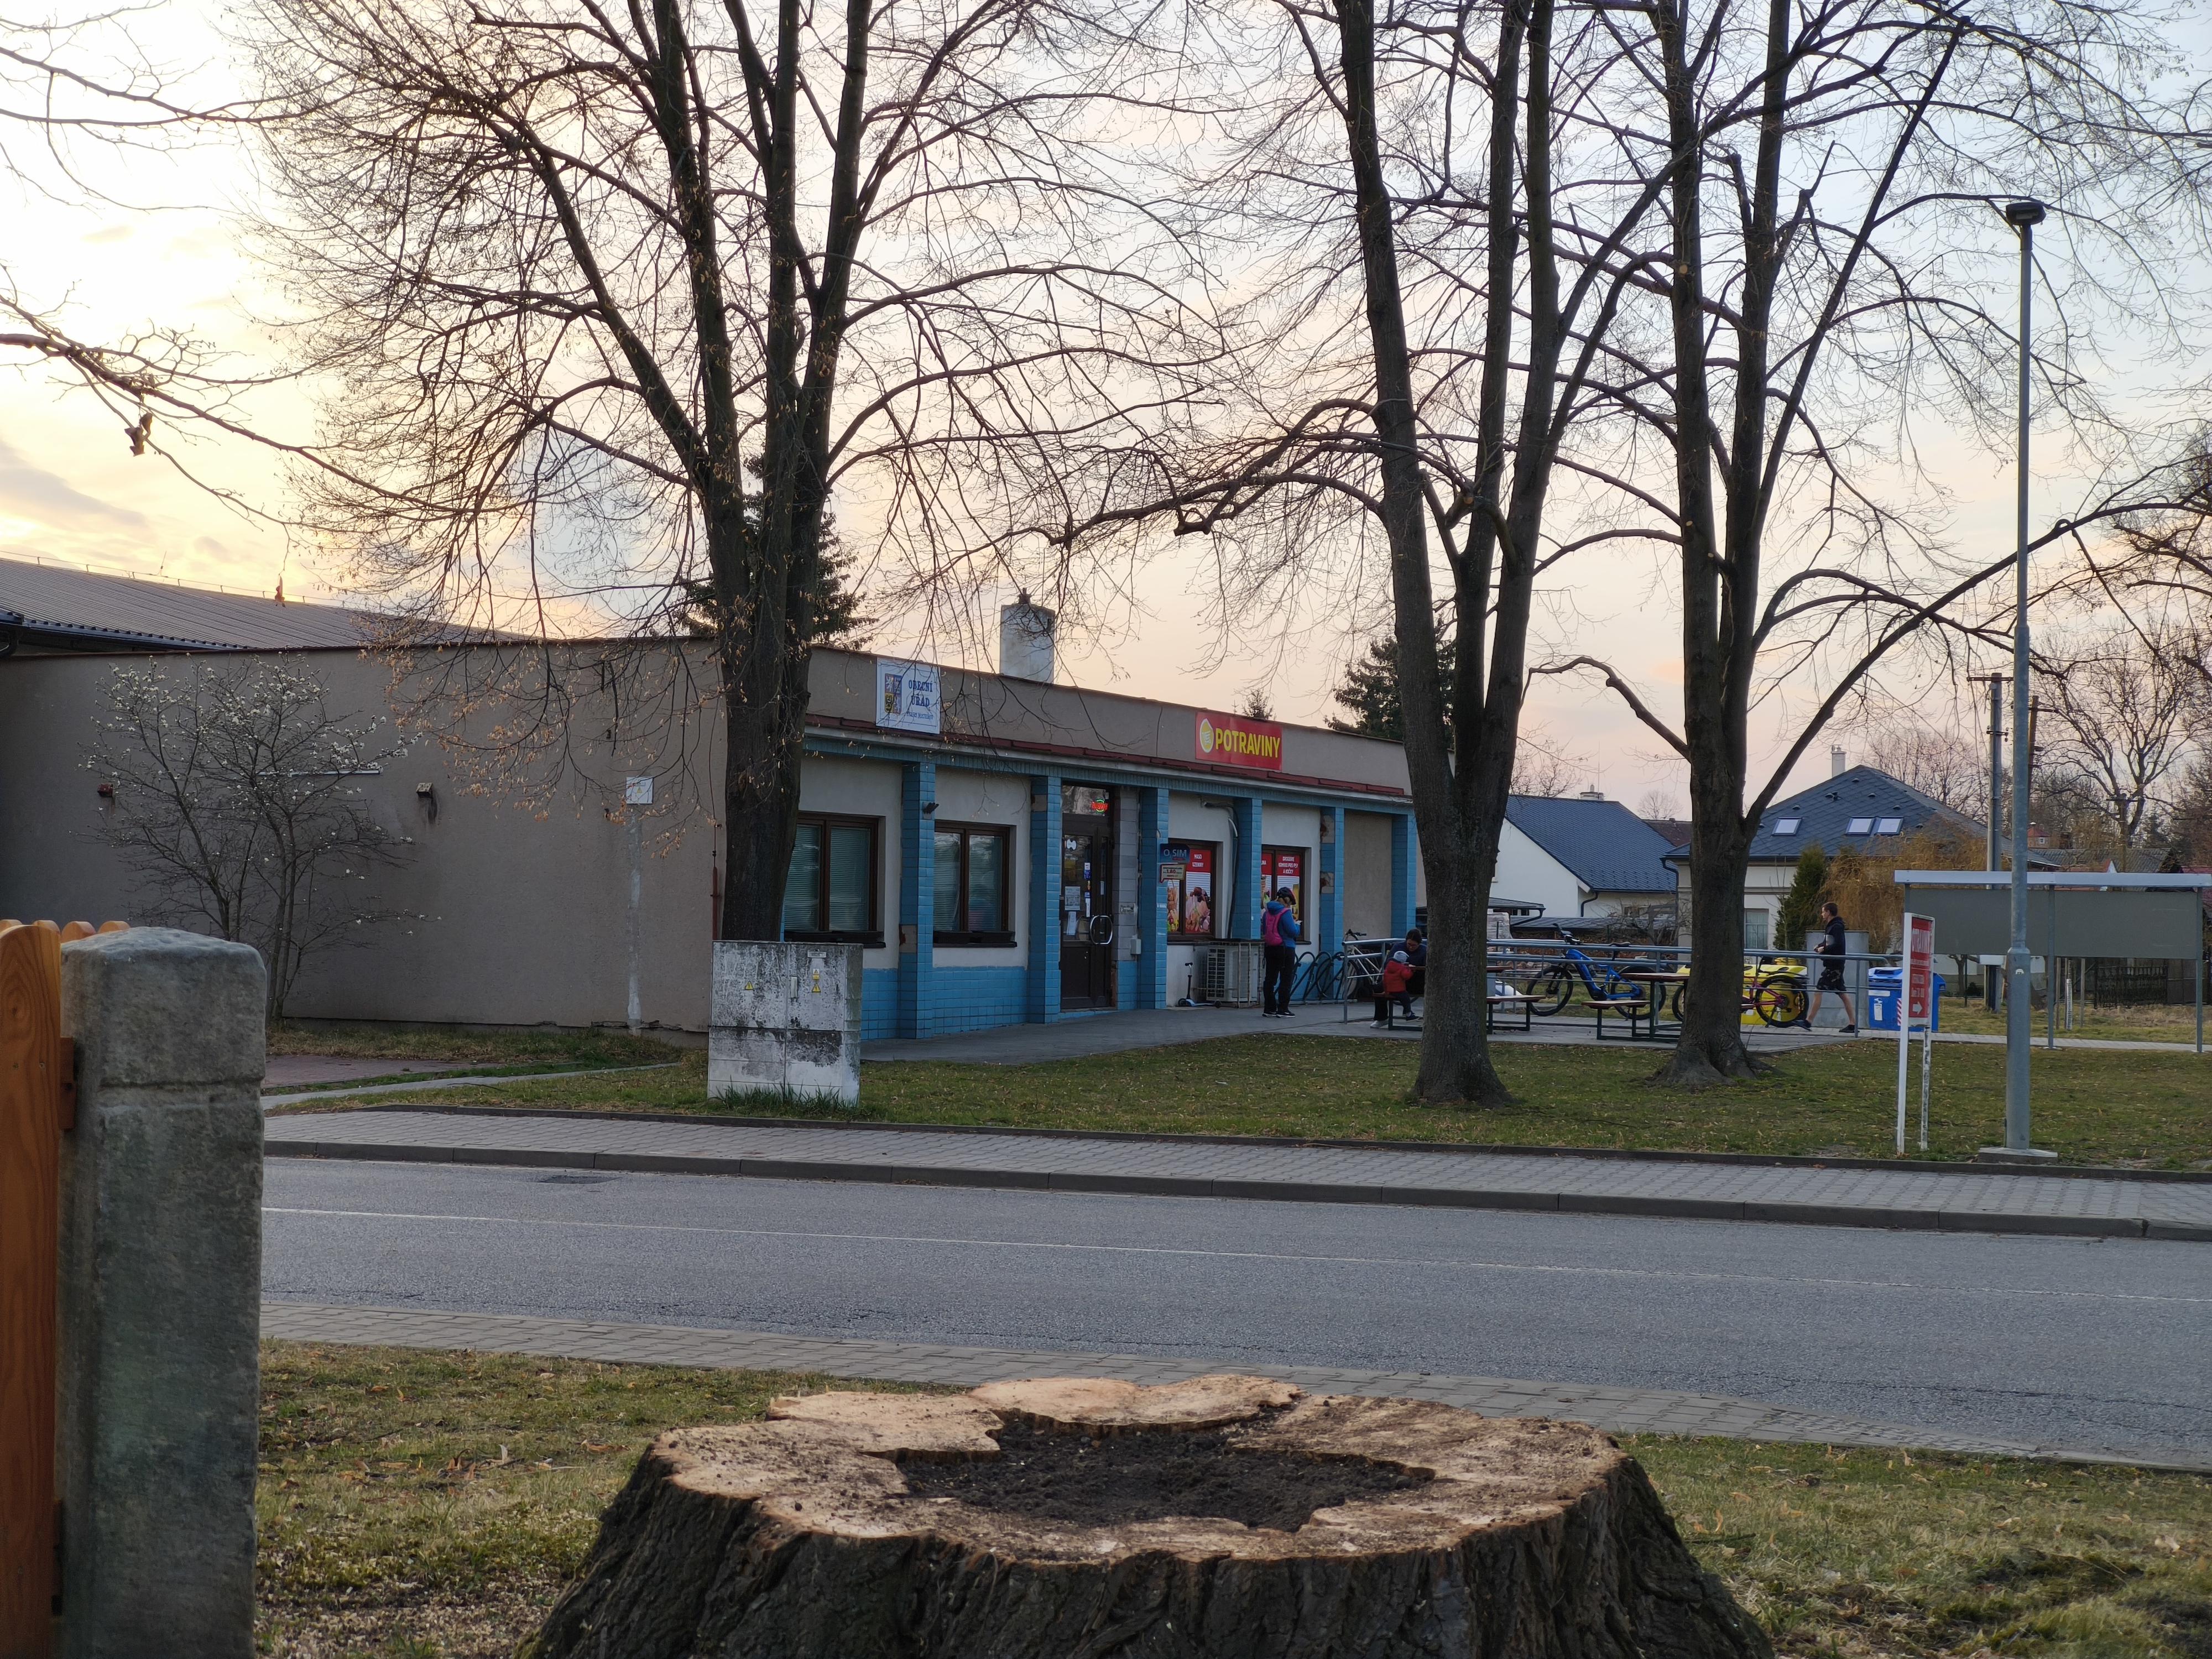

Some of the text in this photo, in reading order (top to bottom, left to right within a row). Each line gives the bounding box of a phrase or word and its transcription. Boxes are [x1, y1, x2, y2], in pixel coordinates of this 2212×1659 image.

[908, 680, 933, 692] OBECNÍ
[911, 693, 930, 707] ÚŘAD
[1215, 728, 1280, 758] POTRAVINY
[1172, 849, 1187, 858] SIM
